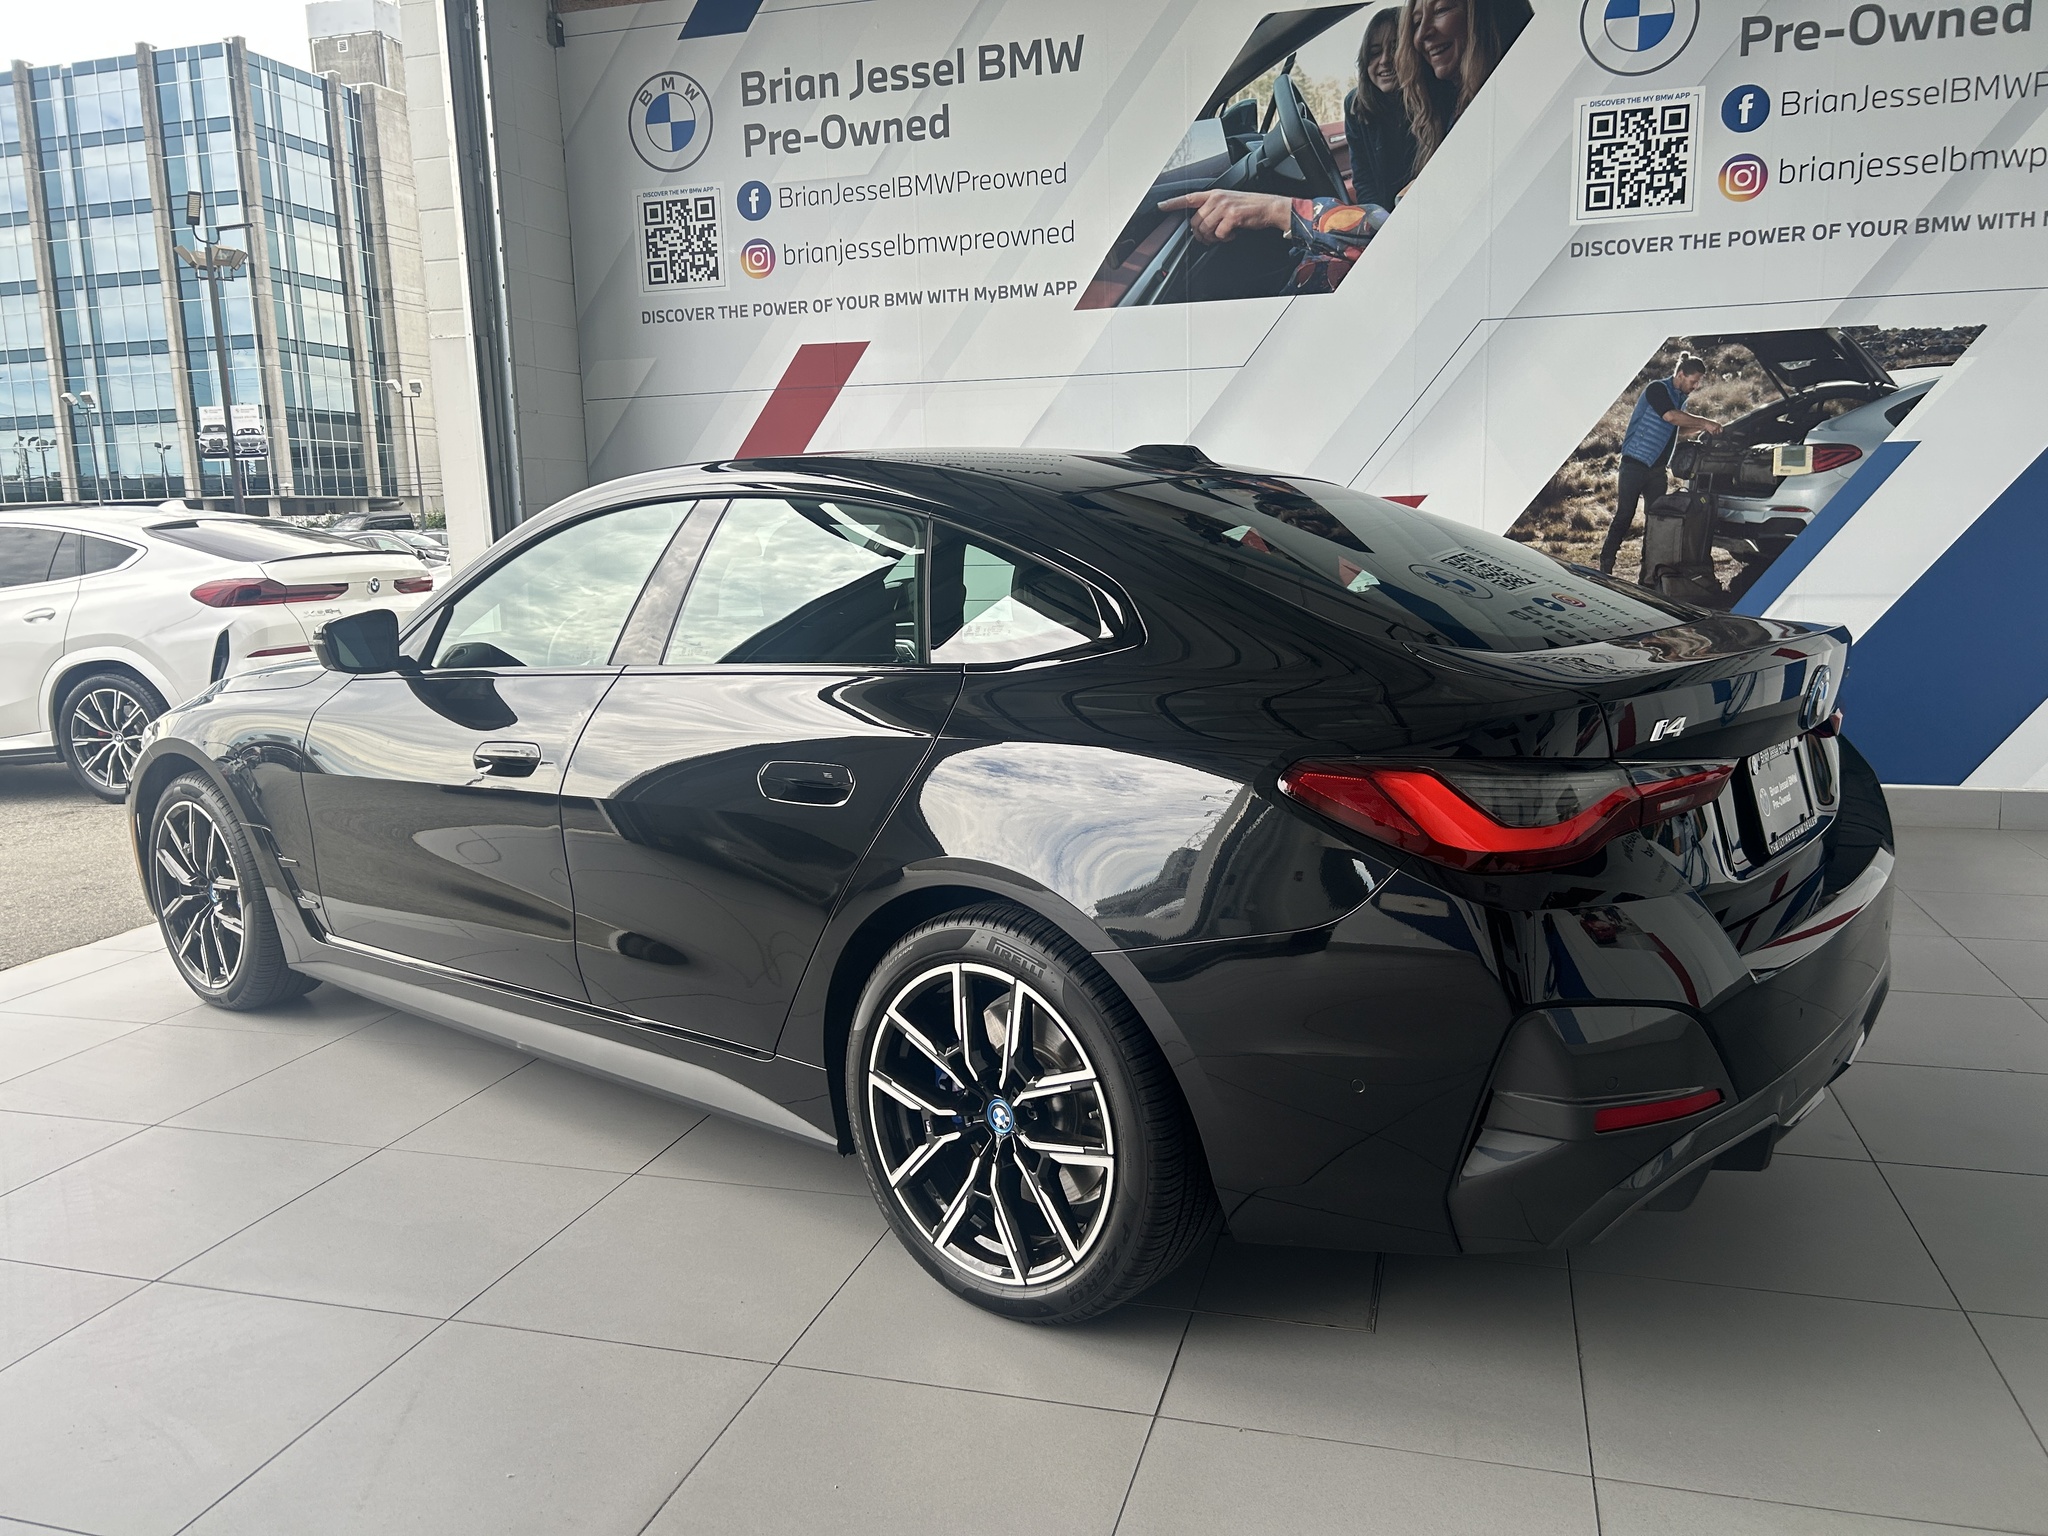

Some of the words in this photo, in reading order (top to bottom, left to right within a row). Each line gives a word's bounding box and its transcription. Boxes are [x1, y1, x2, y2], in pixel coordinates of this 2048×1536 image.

[1740, 0, 2032, 57] Pre-Owned
[638, 76, 700, 107] BMW
[740, 67, 839, 107] Brian
[849, 48, 965, 101] Jessel
[978, 34, 1084, 82] BMW
[1590, 98, 1626, 107] DISCOVER
[1642, 95, 1654, 103] MY
[1675, 92, 1690, 100] APP
[1781, 71, 2048, 117] BrianJesselBMWP
[744, 103, 950, 158] Pre-Owned
[779, 161, 1067, 209] BrianJesselBMWPreowned
[1778, 145, 2048, 186] brianjesselbmwp
[643, 190, 669, 198] DISCOVER
[783, 219, 1075, 267] brianjesselbmwpreowned
[1570, 236, 1674, 258] DISCOVER
[1679, 232, 1722, 250] THE
[1728, 225, 1806, 247] POWER
[1812, 222, 1842, 240] OF
[1846, 218, 1908, 238] YOUR
[1914, 214, 1971, 234] BMW
[1977, 211, 2036, 230] WITH
[642, 306, 715, 324] DISCOVER
[718, 304, 749, 319] THE
[752, 300, 808, 318] POWER
[812, 298, 833, 313] OF
[836, 294, 880, 311] YOUR
[884, 290, 922, 307] BMW
[927, 287, 969, 304] WITH
[974, 283, 1038, 304] MyBMW
[1042, 280, 1077, 296] APP
[1650, 716, 1687, 741] i4
[1769, 785, 1779, 797] Brian
[1779, 779, 1789, 793] Jessel
[1788, 773, 1798, 786] BMW
[1772, 791, 1792, 810] Pre-Owned
[986, 936, 1047, 979] PIRELLI
[1069, 1246, 1121, 1305] ZERO
